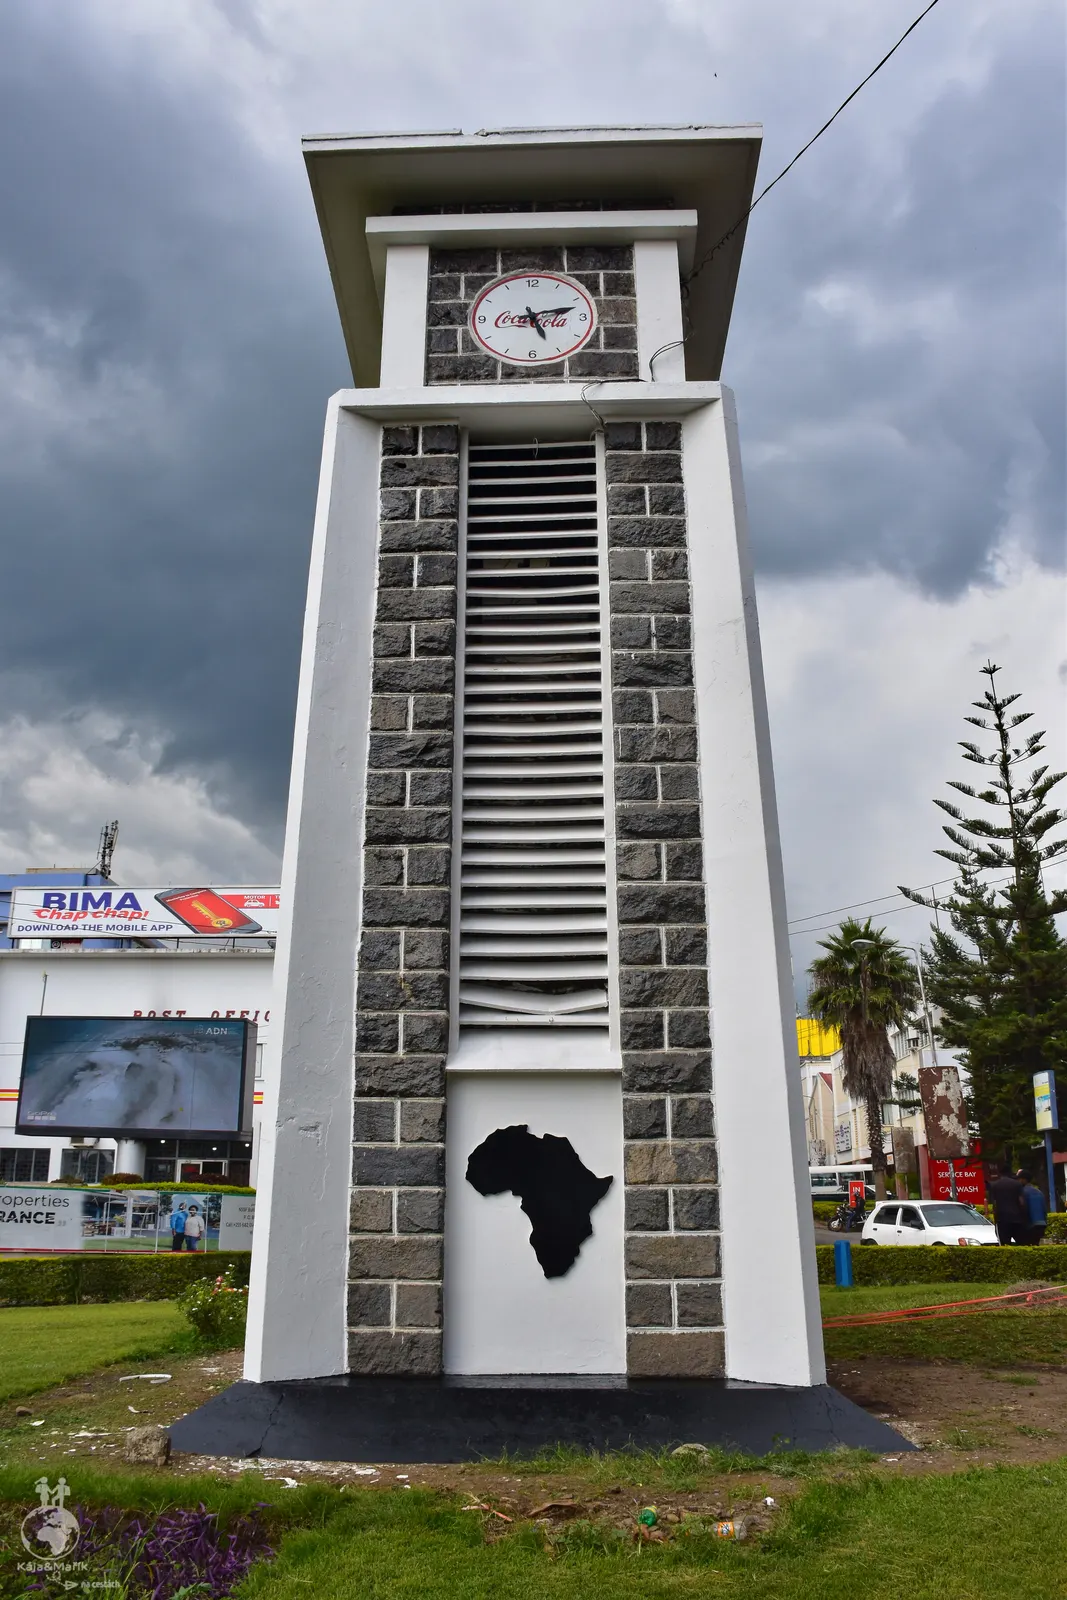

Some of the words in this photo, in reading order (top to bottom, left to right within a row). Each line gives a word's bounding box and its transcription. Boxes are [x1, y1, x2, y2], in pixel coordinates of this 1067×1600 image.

[526, 279, 539, 288] 12
[478, 315, 487, 324] 9
[494, 310, 567, 329] CocaCola
[579, 313, 588, 321] 3
[528, 350, 537, 359] 6
[42, 892, 143, 911] BIMA
[31, 908, 89, 922] Chap
[91, 907, 149, 922] chap!
[17, 924, 79, 932] DOWNLOAD
[82, 924, 103, 932] THE
[105, 924, 148, 932] MOBILE
[150, 924, 173, 932] APP
[205, 1027, 228, 1035] ADN
[956, 1185, 979, 1193] WASH
[0, 1194, 70, 1208] operties
